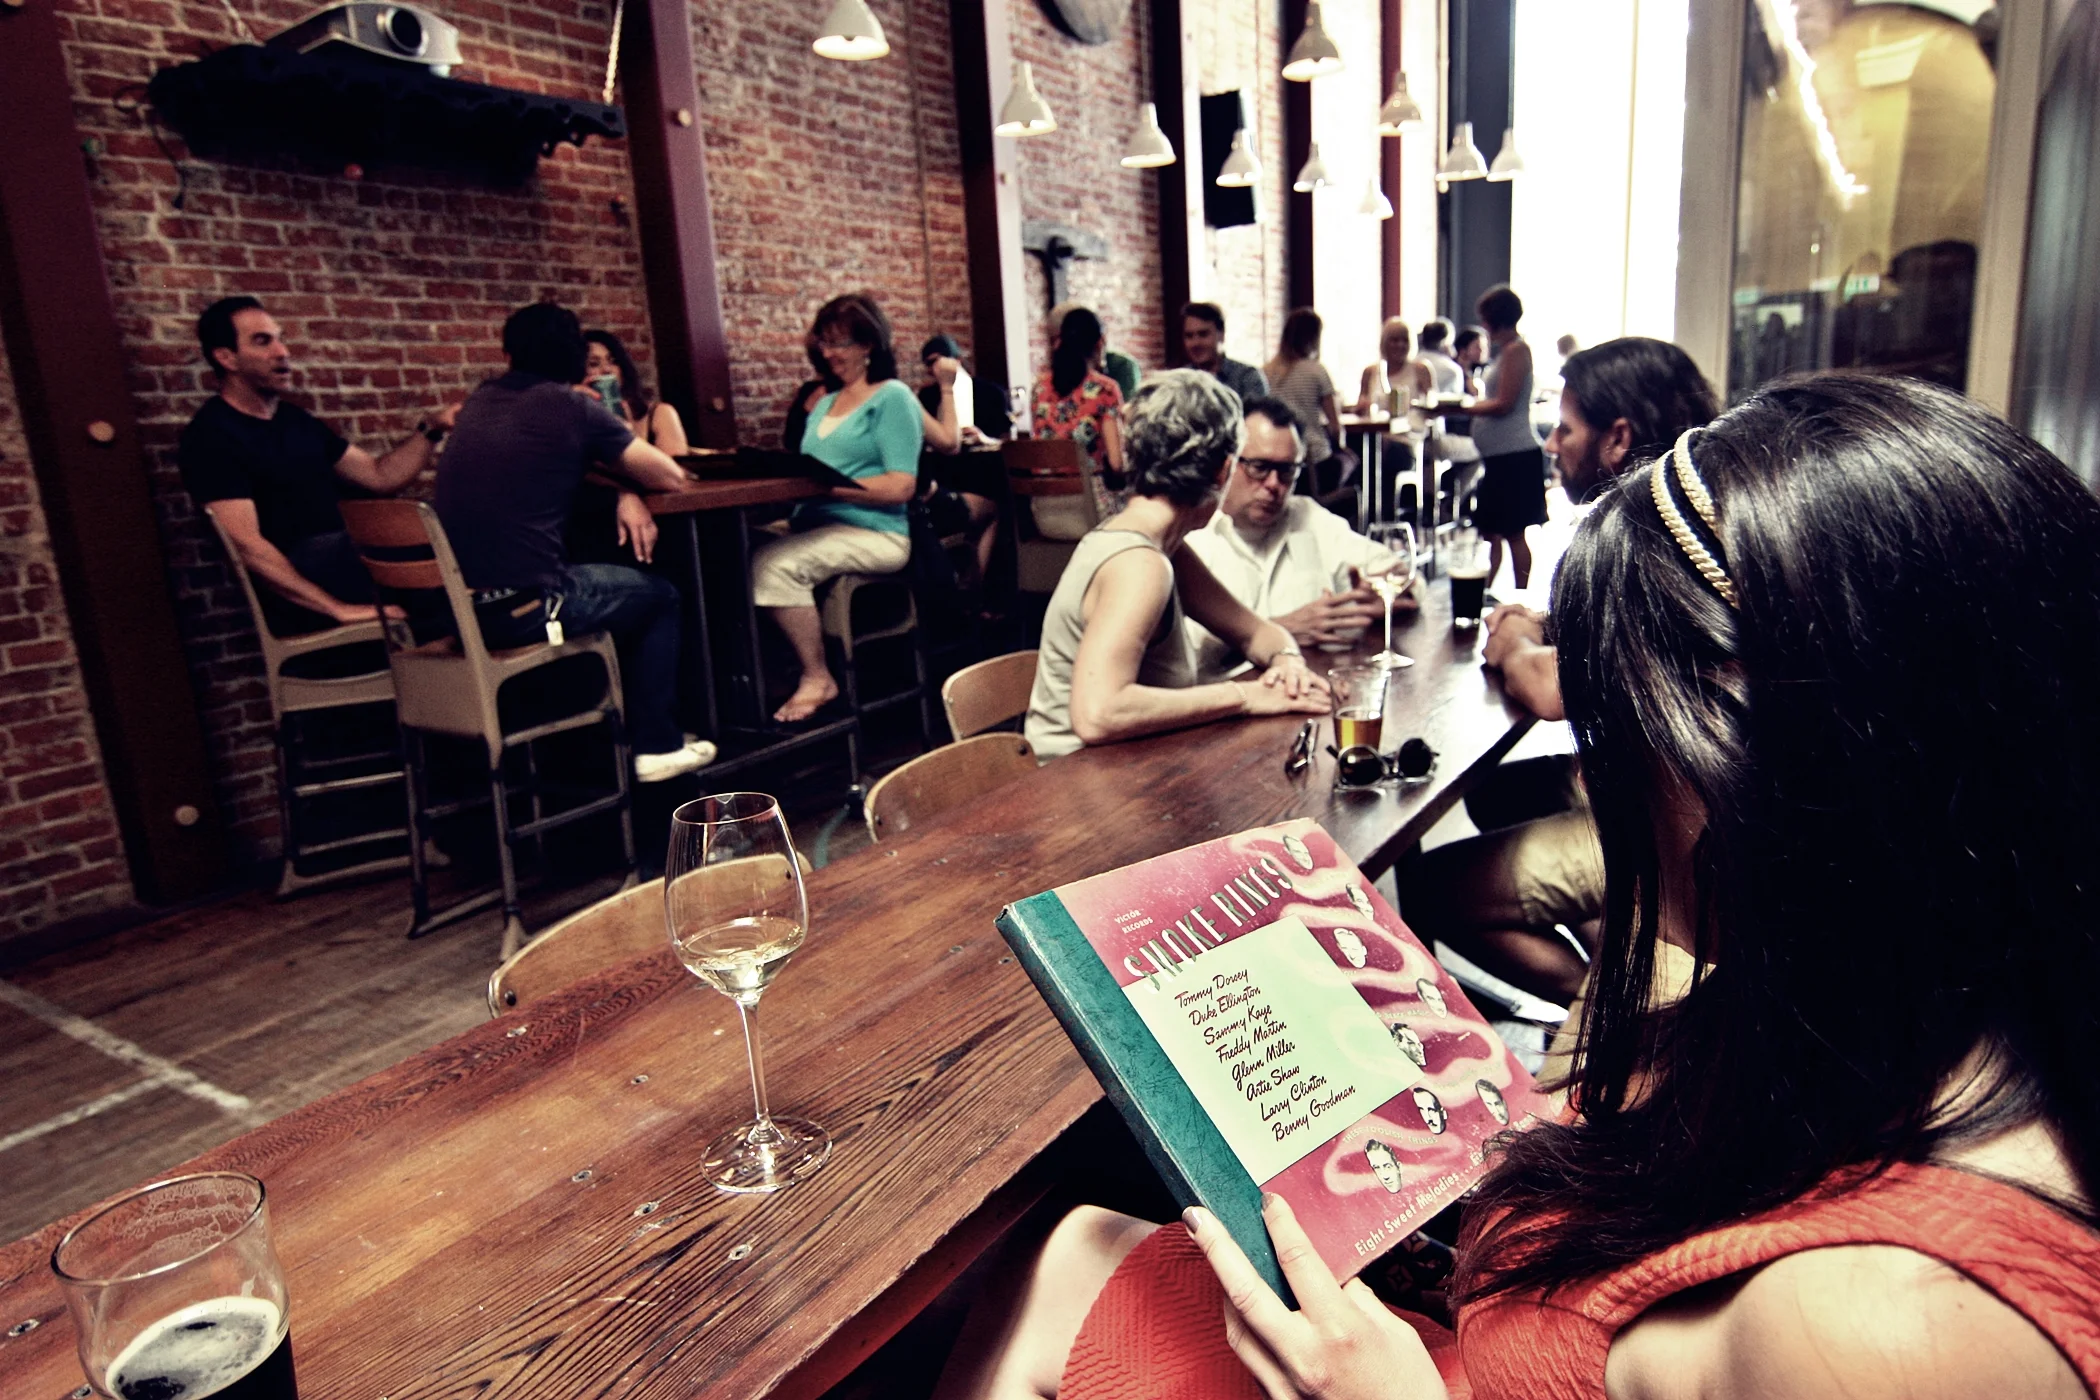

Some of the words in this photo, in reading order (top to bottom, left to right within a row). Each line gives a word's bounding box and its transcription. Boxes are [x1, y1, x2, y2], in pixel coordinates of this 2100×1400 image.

[1114, 909, 1141, 924] VICTOR
[1121, 916, 1154, 935] RECORDS
[1123, 905, 1228, 994] SMOKE
[1210, 858, 1293, 928] RINGS
[1174, 985, 1213, 1008] Tommy
[1212, 969, 1249, 990] Dorsey
[1188, 1004, 1218, 1026] Duke
[1216, 985, 1261, 1013] Ellington
[1203, 1017, 1247, 1045] Sammy
[1247, 1004, 1272, 1024] Kaye
[1216, 1035, 1252, 1063] Freddy
[1253, 1020, 1287, 1044] Martin
[1232, 1059, 1264, 1091] Glenn
[1266, 1038, 1296, 1063] Miller
[1246, 1079, 1273, 1101] Artie
[1270, 1065, 1300, 1086] Shaw
[1260, 1098, 1291, 1121] Larry
[1290, 1075, 1327, 1101] Clinton
[1271, 1113, 1310, 1142] Benny
[1309, 1084, 1356, 1117] Goodman
[1408, 1135, 1438, 1145] THINGS
[1354, 1228, 1386, 1256] Eight
[1383, 1204, 1417, 1233] Sweet
